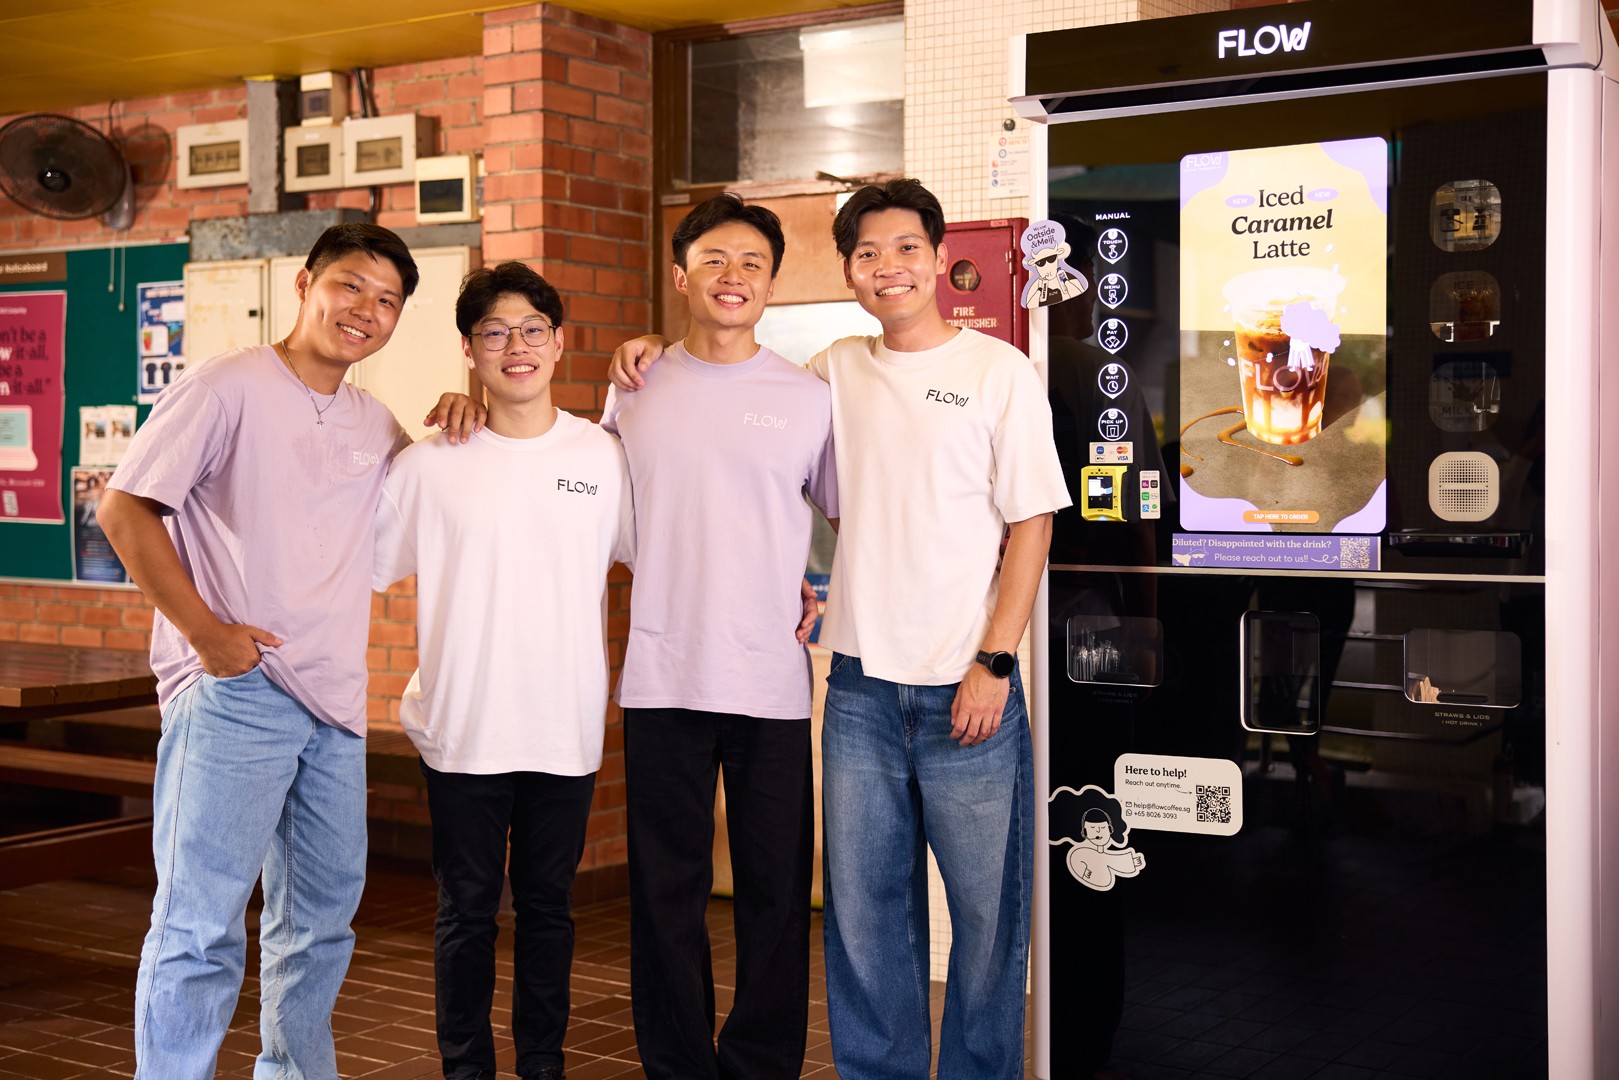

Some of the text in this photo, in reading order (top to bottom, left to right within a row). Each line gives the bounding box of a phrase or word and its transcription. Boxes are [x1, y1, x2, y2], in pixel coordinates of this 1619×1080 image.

[1218, 21, 1312, 58] FLOW
[1186, 154, 1222, 168] FLOW
[1258, 184, 1304, 208] Iced
[1096, 212, 1130, 220] MANUAL
[1231, 208, 1333, 235] Caramel
[1026, 227, 1056, 241] Oatside
[1031, 234, 1054, 248] &Meiji
[1252, 239, 1311, 259] Latte
[1454, 280, 1474, 289] ICE
[953, 306, 975, 317] FIRE
[946, 318, 997, 328] TINGUISHER
[20, 326, 35, 343] be
[38, 329, 46, 342] a
[926, 389, 969, 407] FLOW
[1441, 406, 1472, 415] MILK
[743, 413, 788, 430] FLOW
[353, 451, 379, 466] FLOW
[557, 478, 598, 496] FLOW
[1172, 538, 1207, 546] Diluted?
[1208, 539, 1264, 549] Disappointed
[1303, 540, 1332, 548] drink?
[1214, 553, 1241, 561] Please
[1243, 554, 1266, 562] reach
[1295, 555, 1309, 563] us!!
[1125, 765, 1187, 779] Here to help!
[1134, 802, 1191, 813] help@flowcoffee.sg
